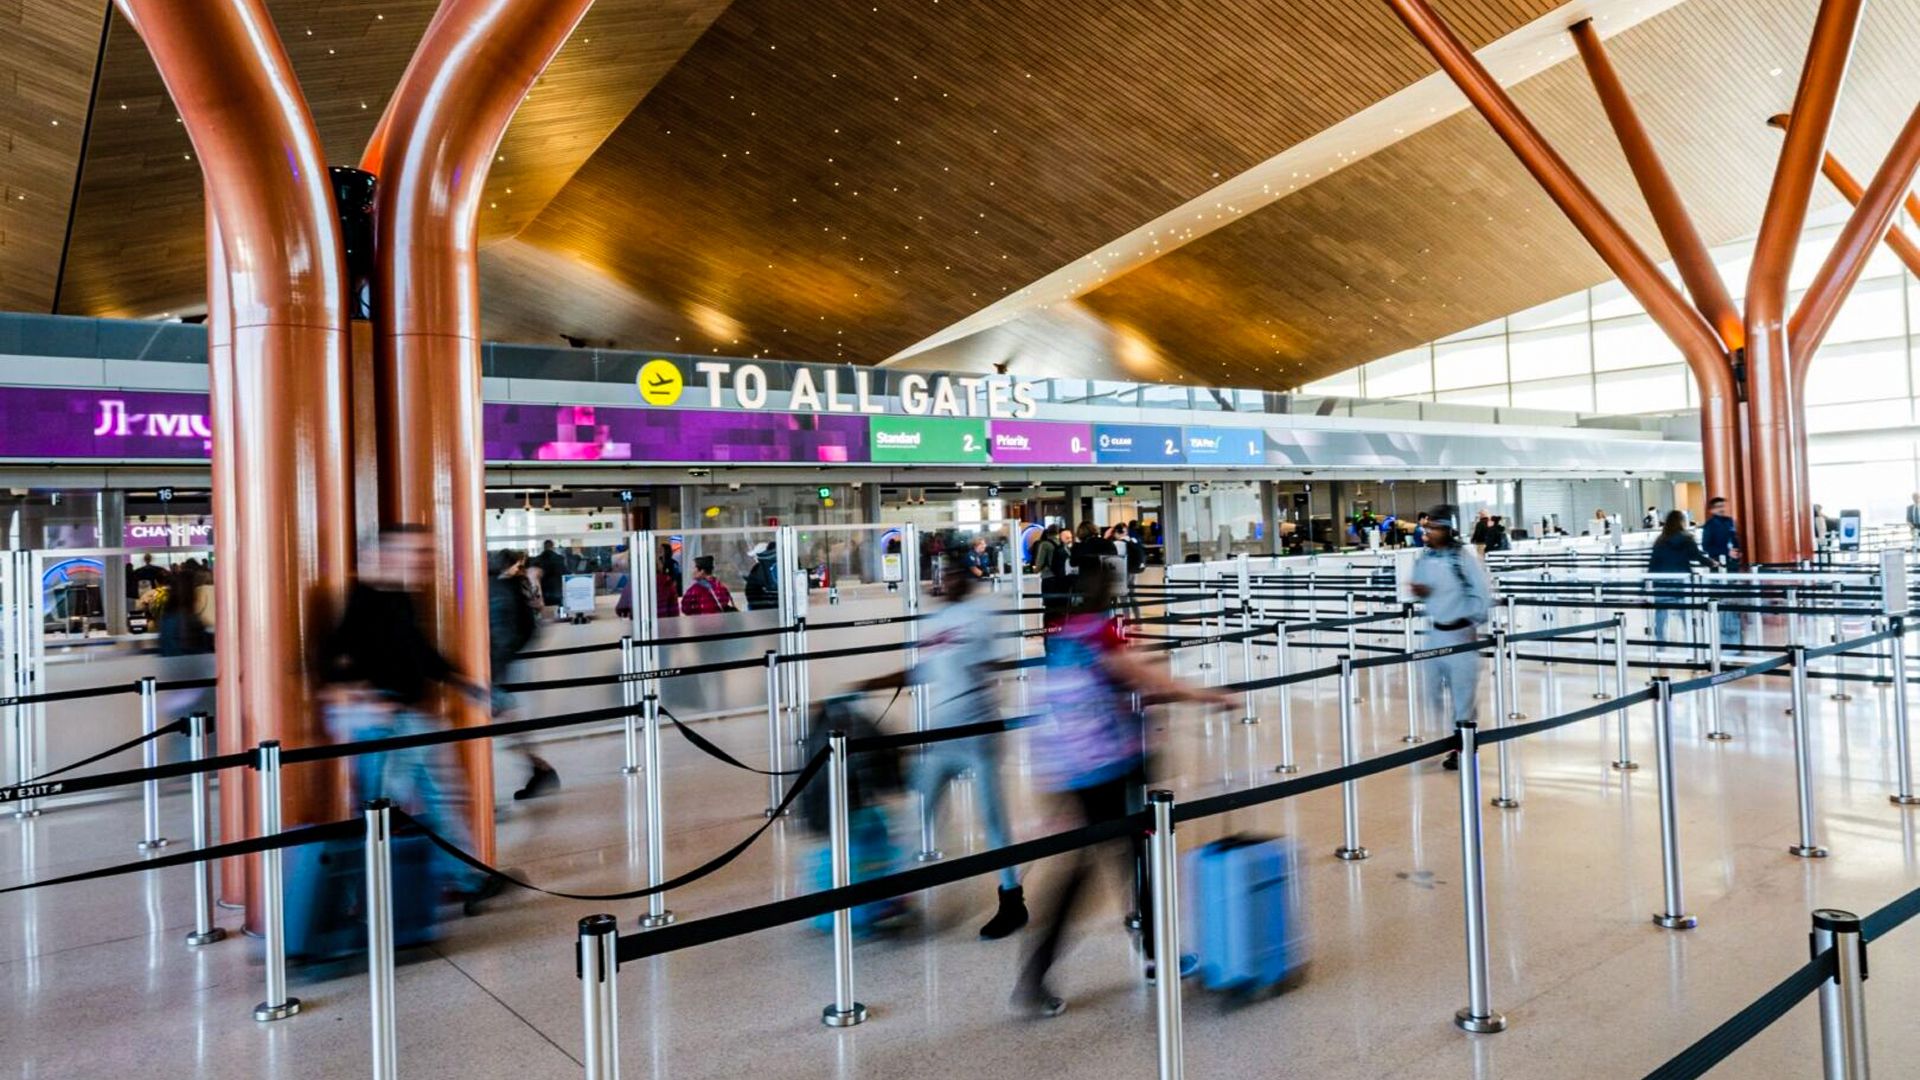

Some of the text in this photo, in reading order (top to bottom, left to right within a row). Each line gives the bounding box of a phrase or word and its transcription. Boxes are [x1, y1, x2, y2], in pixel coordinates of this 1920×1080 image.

[696, 362, 1037, 418] TO ALL GATES
[876, 432, 921, 444] Standard
[963, 434, 974, 452] 2
[996, 434, 1029, 448] Priority
[1111, 438, 1132, 446] CLEAR
[1071, 437, 1080, 453] 0
[1165, 439, 1175, 455] 2
[159, 489, 171, 500] 16
[621, 490, 632, 501] 14
[17, 785, 48, 798] EXIT
